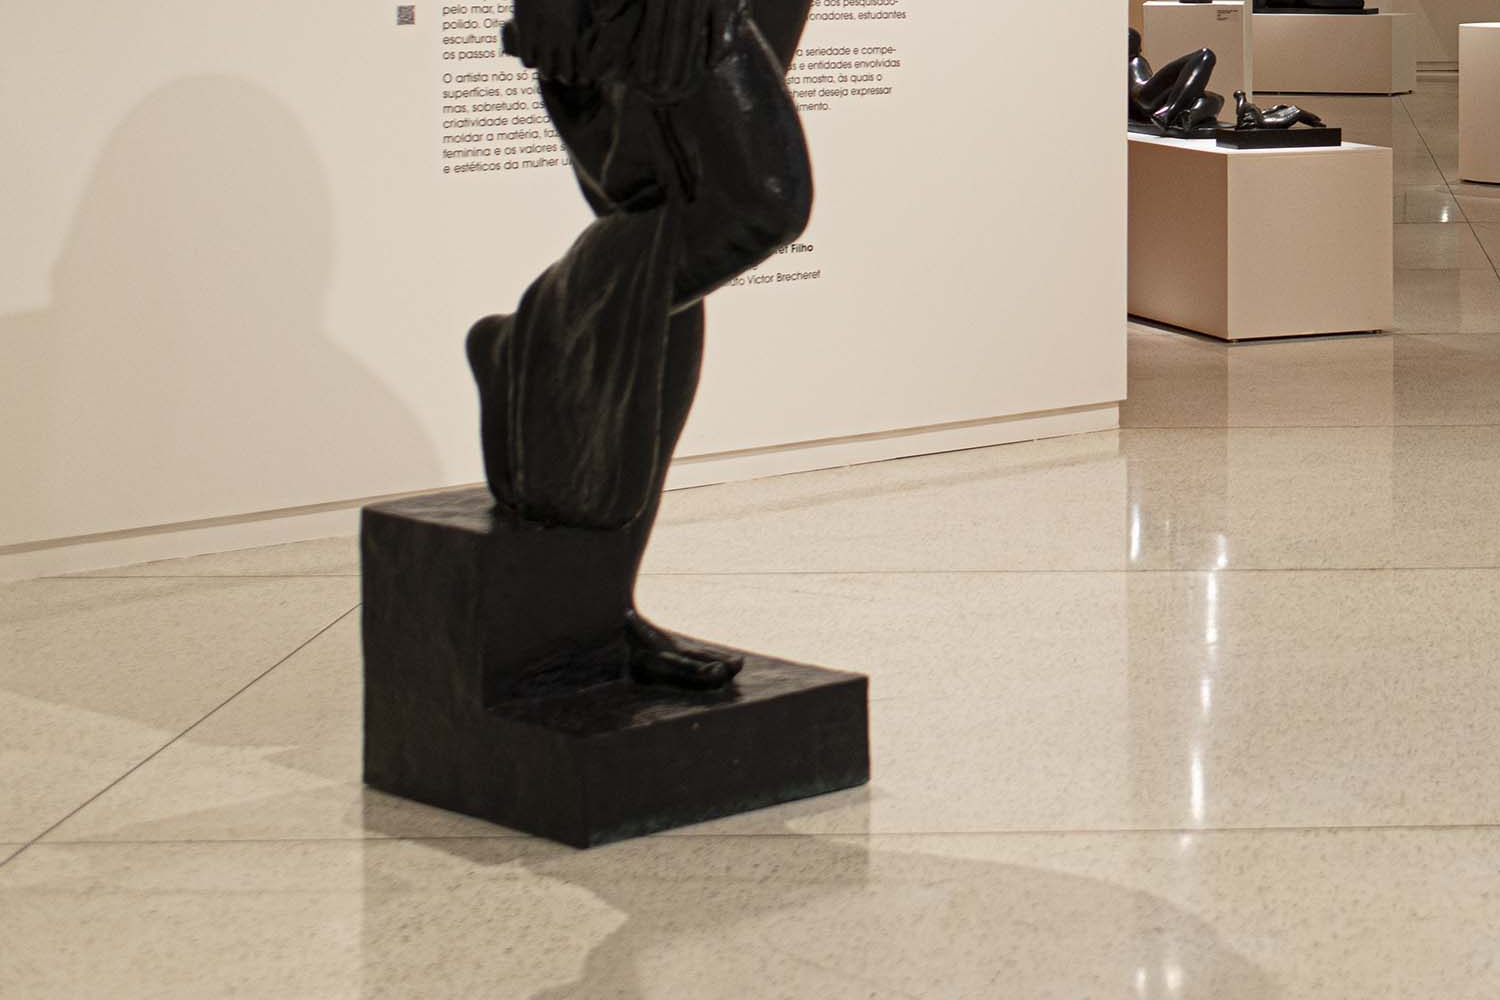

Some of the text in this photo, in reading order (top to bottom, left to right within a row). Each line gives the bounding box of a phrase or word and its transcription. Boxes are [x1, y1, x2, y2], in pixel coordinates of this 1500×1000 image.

[858, 10, 906, 19] estudantes
[442, 34, 497, 44] esculturas
[805, 46, 850, 56] seriedade
[861, 46, 896, 55] compe-
[456, 72, 488, 83] artista
[491, 71, 512, 81] não
[505, 87, 517, 96] os
[818, 86, 891, 98] deseja expressar
[442, 117, 508, 128] criatividade
[443, 133, 483, 143] moldar
[442, 147, 490, 158] feminina
[504, 146, 516, 155] os
[519, 143, 556, 154] valores
[453, 160, 500, 173] estéticos
[503, 160, 518, 170] da
[522, 157, 558, 168] mulher
[791, 244, 814, 252] Filho
[747, 269, 820, 284] Victor Brecheret
